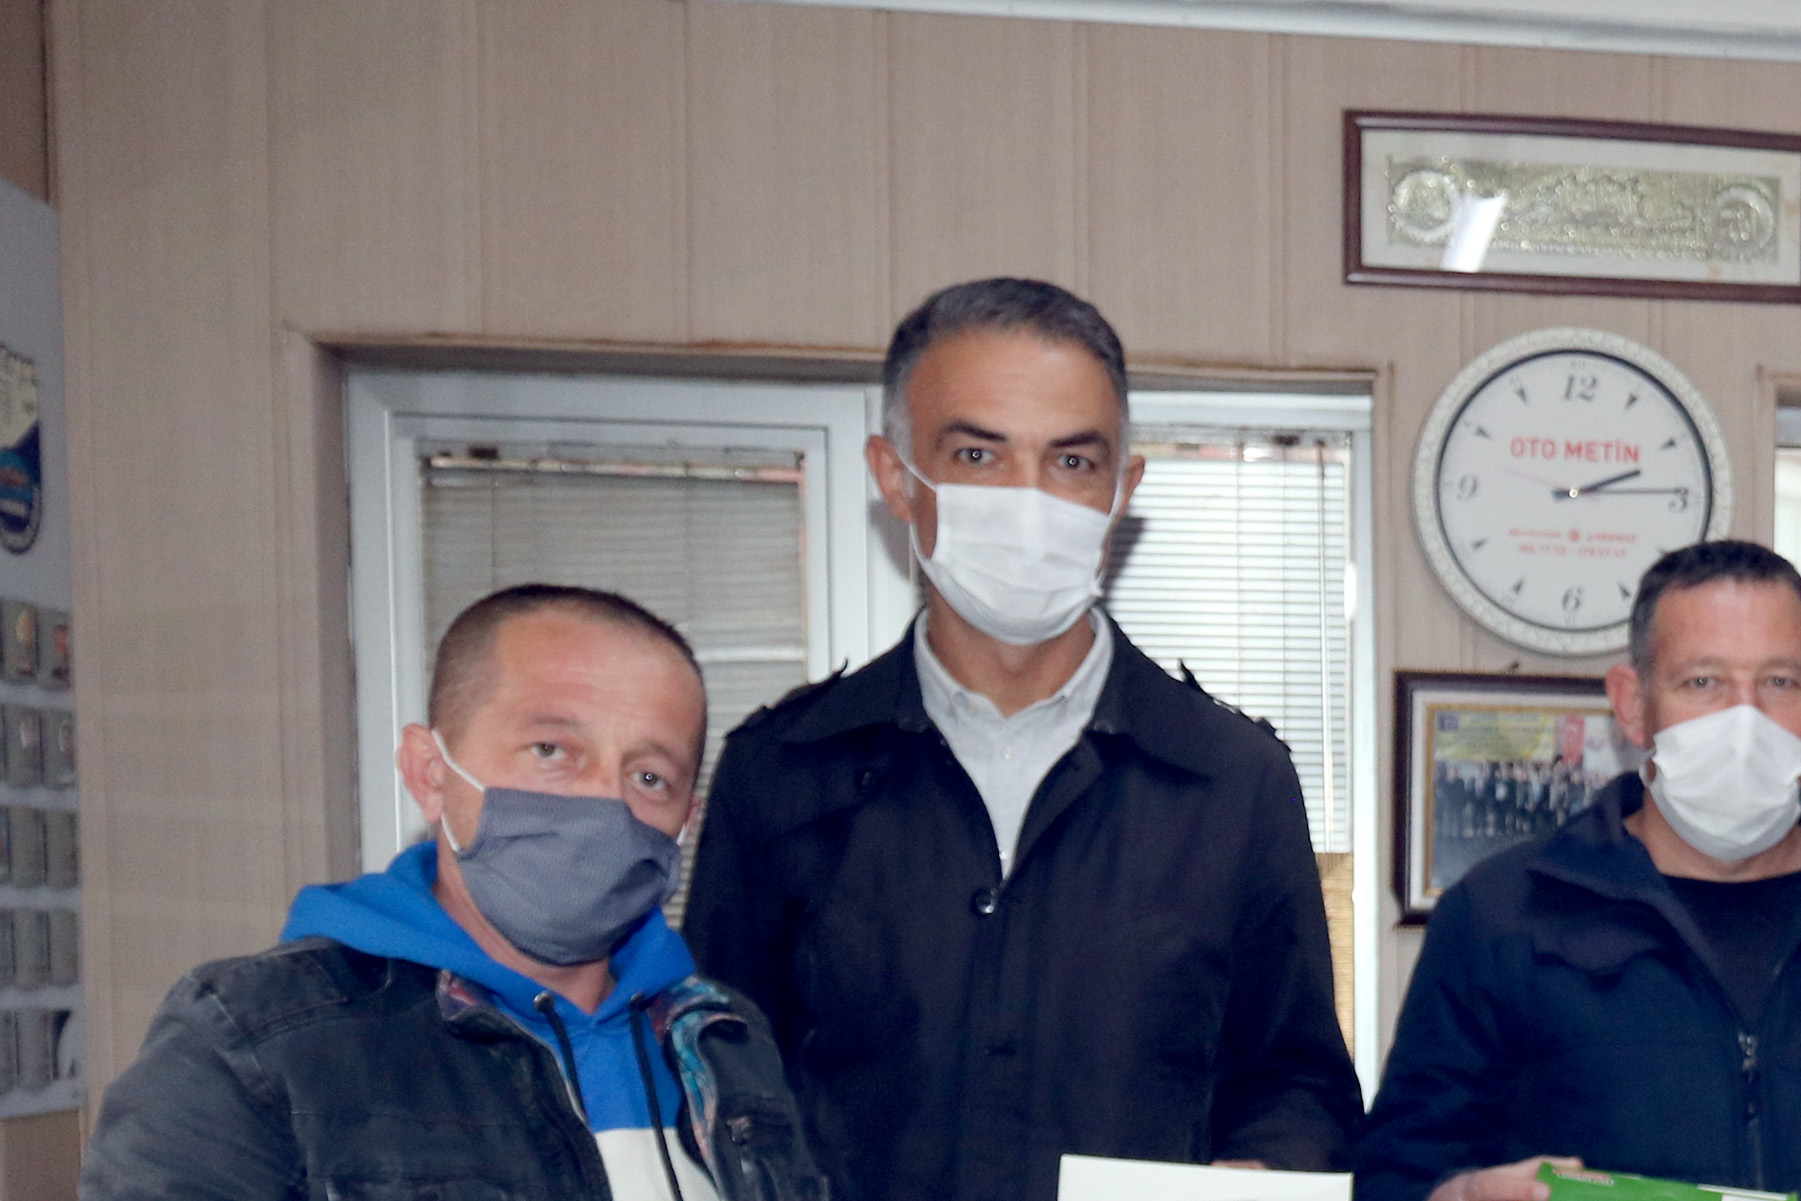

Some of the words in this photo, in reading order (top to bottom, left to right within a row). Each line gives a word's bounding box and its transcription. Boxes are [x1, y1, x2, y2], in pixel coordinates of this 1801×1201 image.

[1563, 373, 1597, 401] 12
[1510, 436, 1556, 459] OTO
[1564, 438, 1641, 463] METİN
[1457, 473, 1478, 501] 9
[1561, 586, 1583, 612] 6
